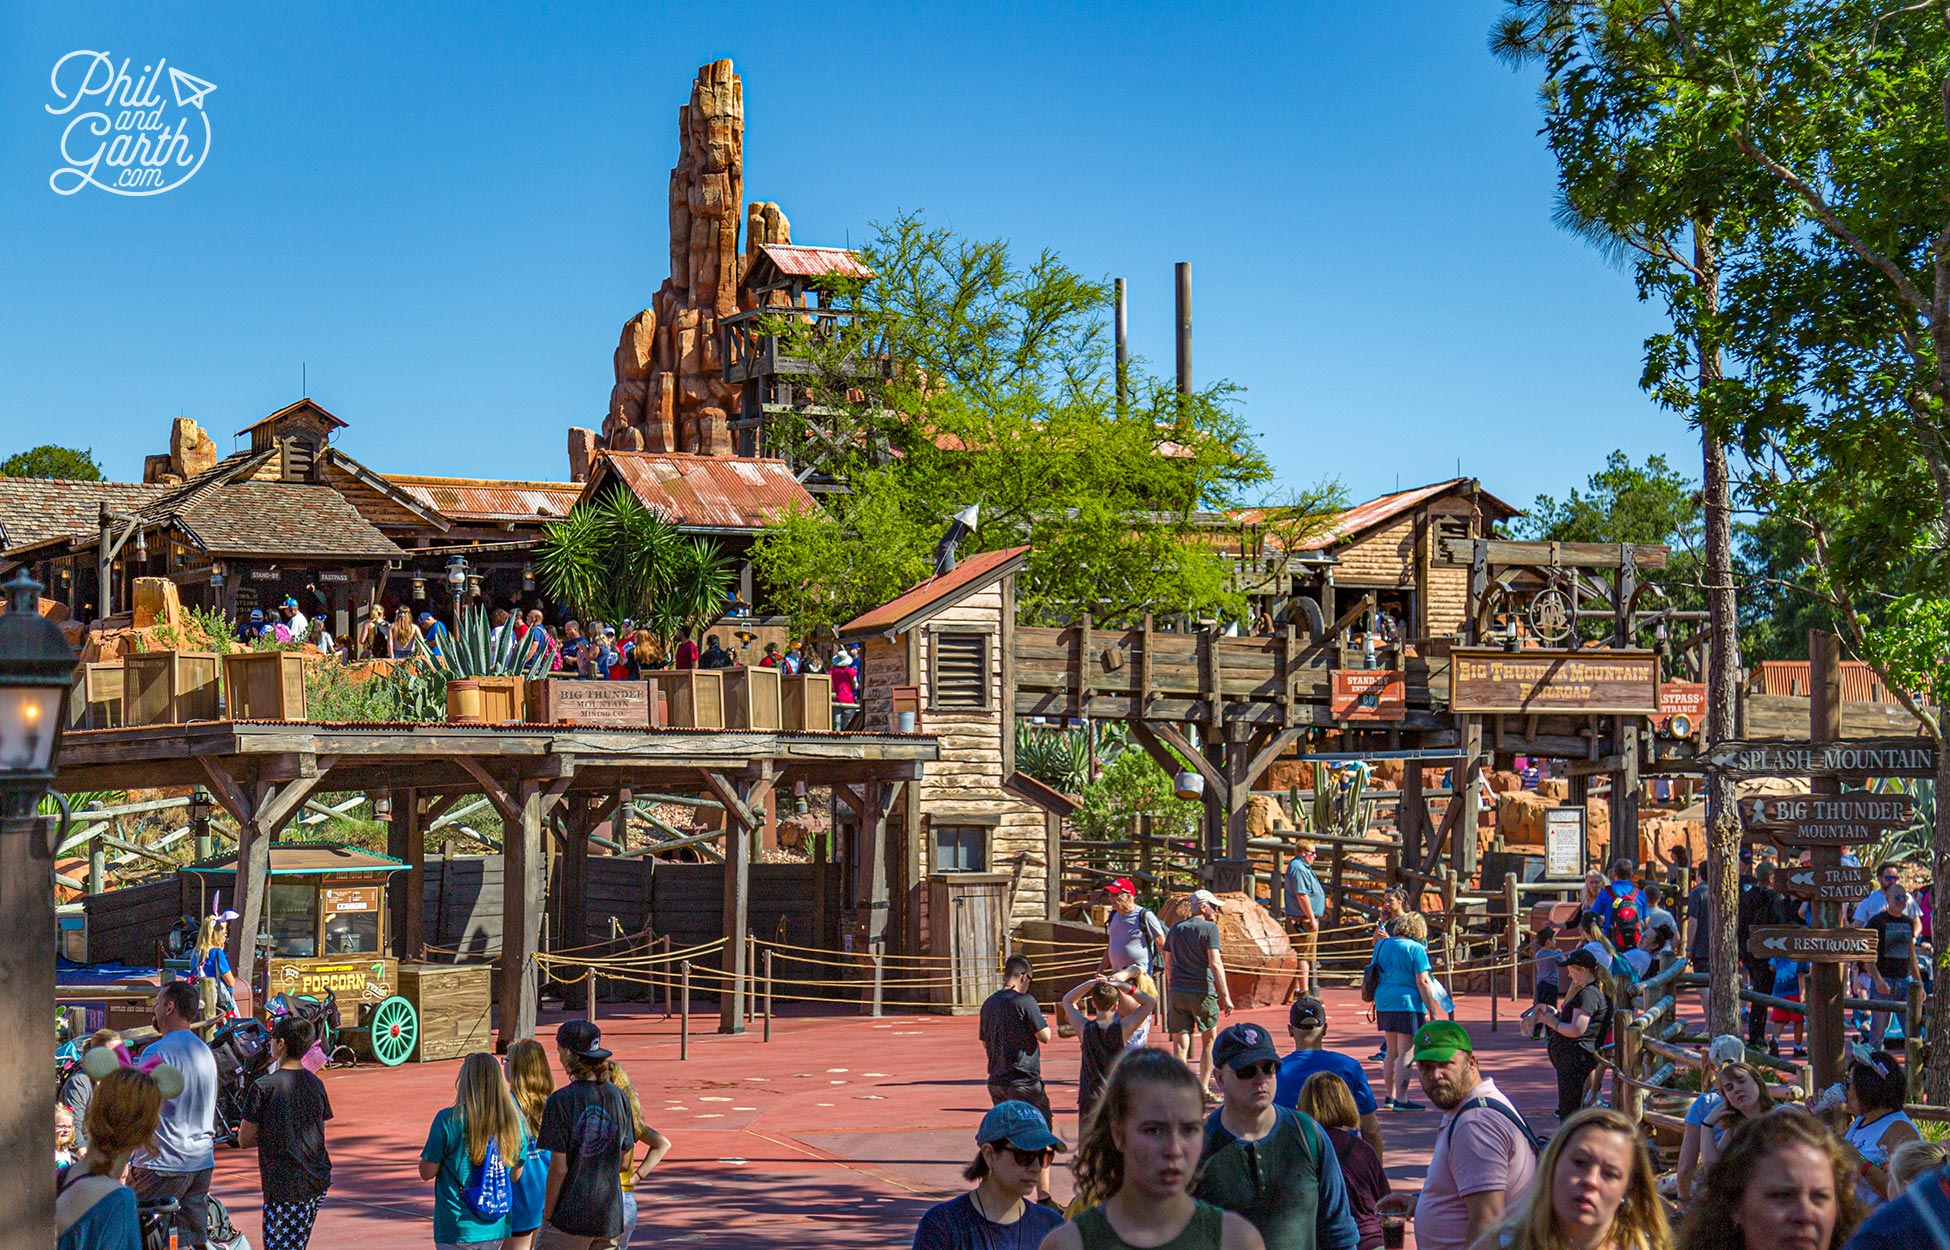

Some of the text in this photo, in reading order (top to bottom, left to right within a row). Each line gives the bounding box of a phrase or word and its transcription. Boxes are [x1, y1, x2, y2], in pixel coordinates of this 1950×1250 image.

[1459, 662, 1650, 682] BIG THUNDER MOUNTAIN
[1347, 676, 1389, 685] STAND-BY
[560, 690, 644, 699] BIG THUNDER
[1520, 683, 1591, 700] RAILROAD
[577, 700, 629, 708] MOUNTAIN
[1362, 695, 1375, 704] 60
[1738, 749, 1932, 771] SPLASH MOUNTAIN
[1776, 801, 1906, 821] BIG THUNDER
[1797, 824, 1869, 838] MOUNTAIN
[1825, 870, 1861, 883] TRAIN
[1820, 885, 1870, 897] STATION
[1793, 937, 1869, 952] RESTROOMS
[285, 968, 300, 979] HOT
[302, 974, 366, 993] POPCORN
[366, 981, 388, 997] FRESH
